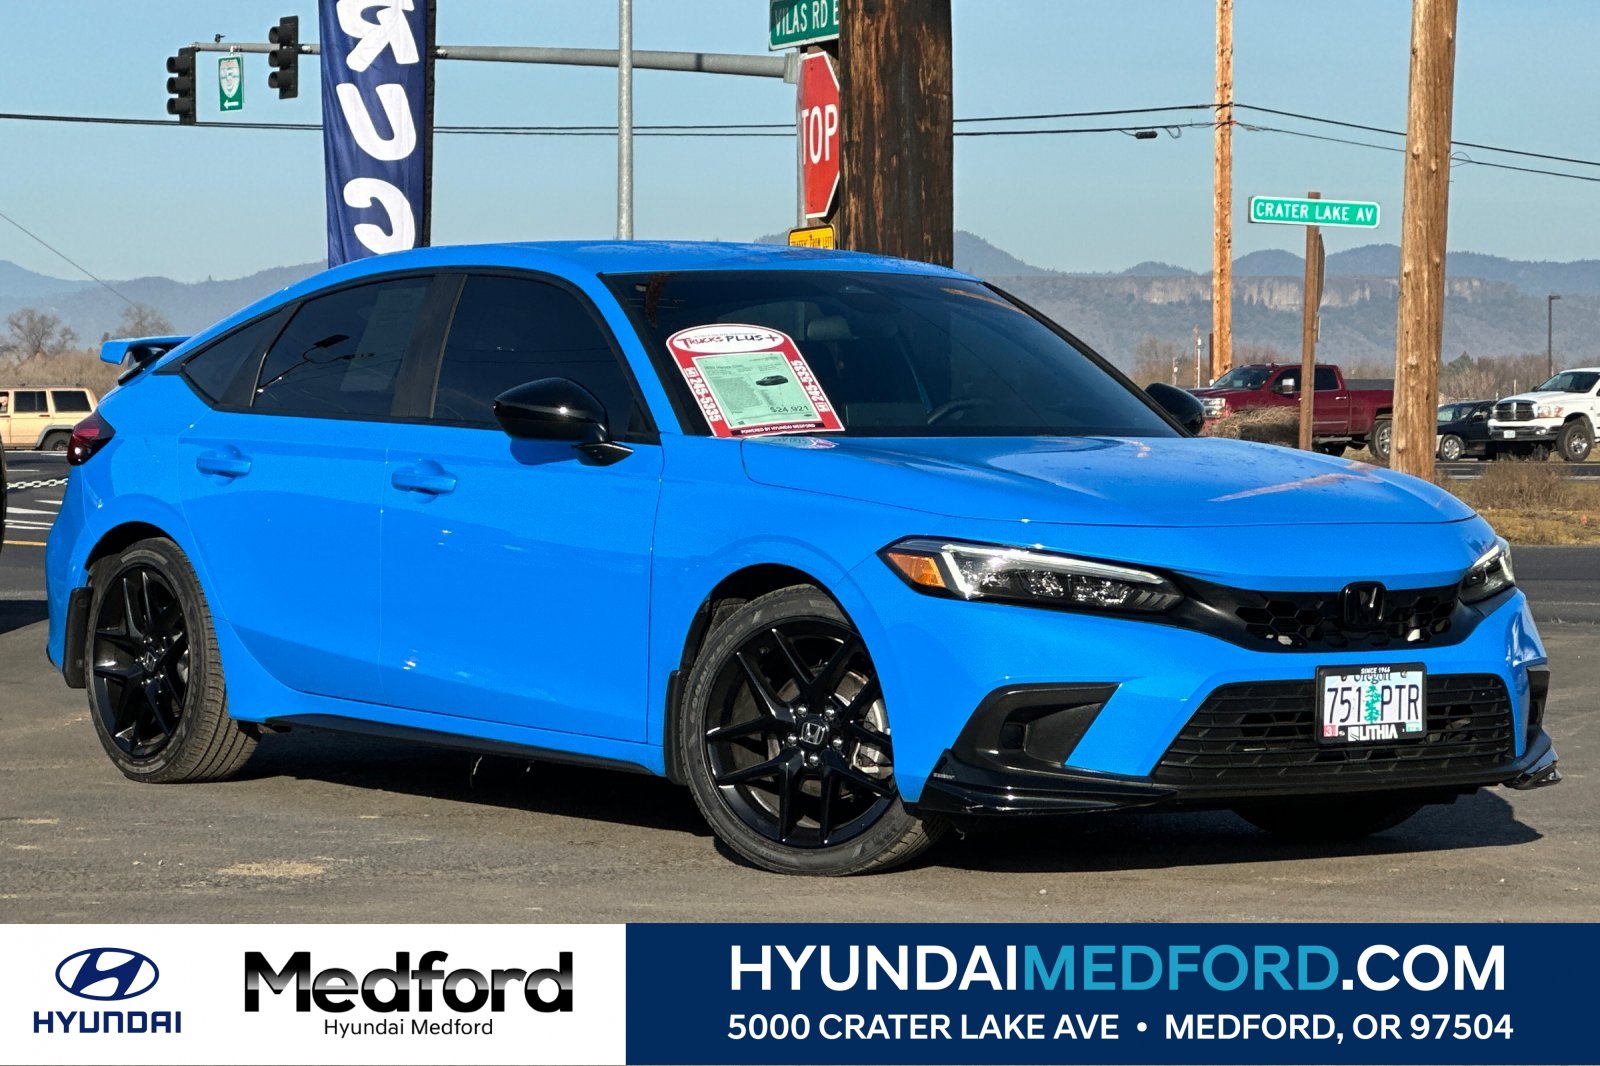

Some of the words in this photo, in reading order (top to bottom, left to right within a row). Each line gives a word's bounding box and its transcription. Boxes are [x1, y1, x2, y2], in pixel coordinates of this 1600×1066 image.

[774, 3, 808, 37] VILAS
[812, 0, 829, 30] RD
[801, 103, 838, 165] TOP
[1256, 201, 1309, 219] CRATER
[1315, 205, 1350, 221] LAKE
[1355, 207, 1375, 222] AV
[1327, 686, 1362, 723] 751
[1380, 684, 1419, 721] PTR
[1359, 723, 1398, 741] LITHIA
